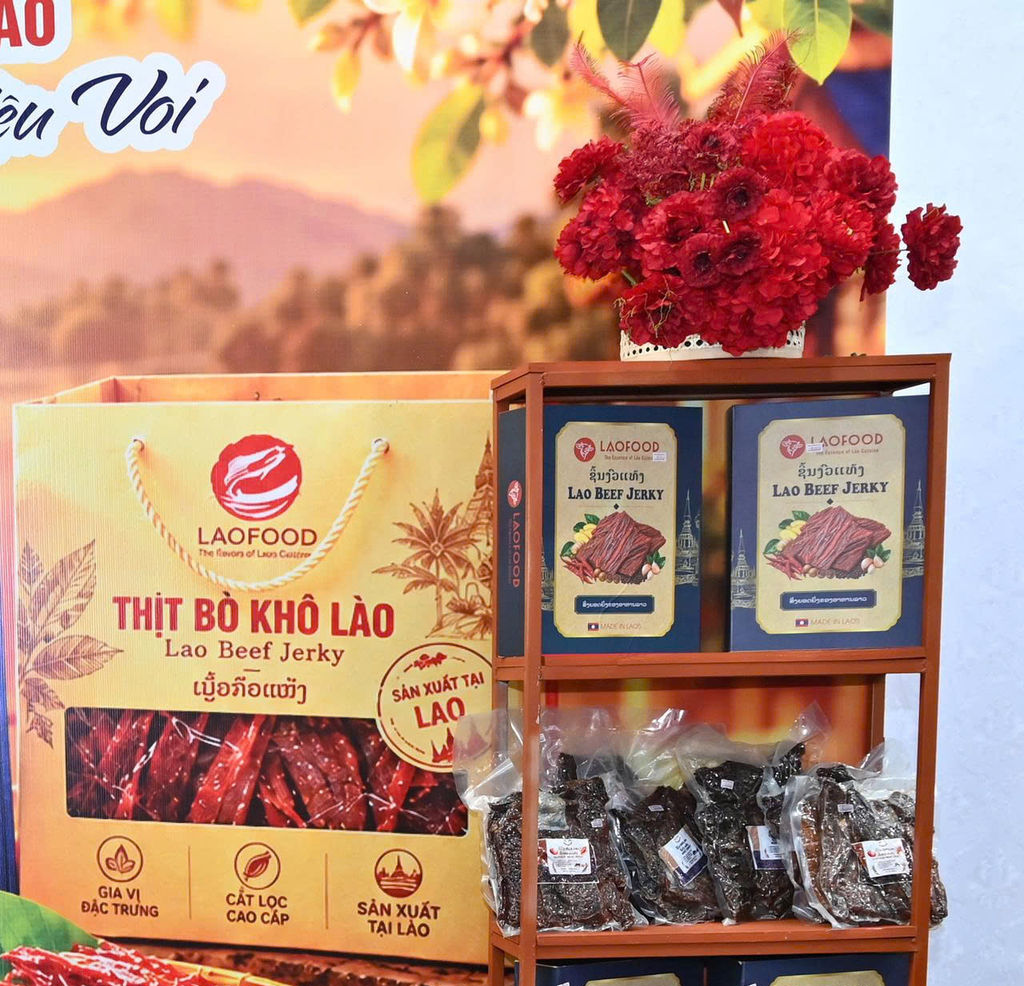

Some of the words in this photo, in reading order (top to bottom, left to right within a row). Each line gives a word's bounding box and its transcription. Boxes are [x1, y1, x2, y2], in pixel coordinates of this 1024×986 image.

[72, 70, 209, 137] Voi
[600, 440, 660, 453] LAOFOOD
[568, 486, 592, 500] LAO
[595, 486, 624, 500] BEEF
[626, 487, 664, 500] JERKY
[772, 484, 800, 497] LAO
[804, 483, 839, 496] BEEF
[842, 481, 889, 494] JERKY
[198, 526, 317, 546] LAOFOOD
[512, 512, 521, 588] LAOFOOD
[112, 593, 183, 638] THỊT
[194, 591, 239, 633] BÒ
[250, 593, 320, 635] KHÔ
[331, 595, 395, 638] LÀO
[165, 640, 208, 659] Lao
[218, 640, 273, 661] Beef
[280, 642, 344, 667] Jerky
[414, 696, 466, 729] LAO
[98, 885, 124, 899] GIA
[127, 887, 141, 904] VỊ
[258, 894, 288, 912] LỌC
[227, 908, 256, 923] CAO
[368, 919, 395, 937] TẠI
[398, 918, 430, 938] LÀO
